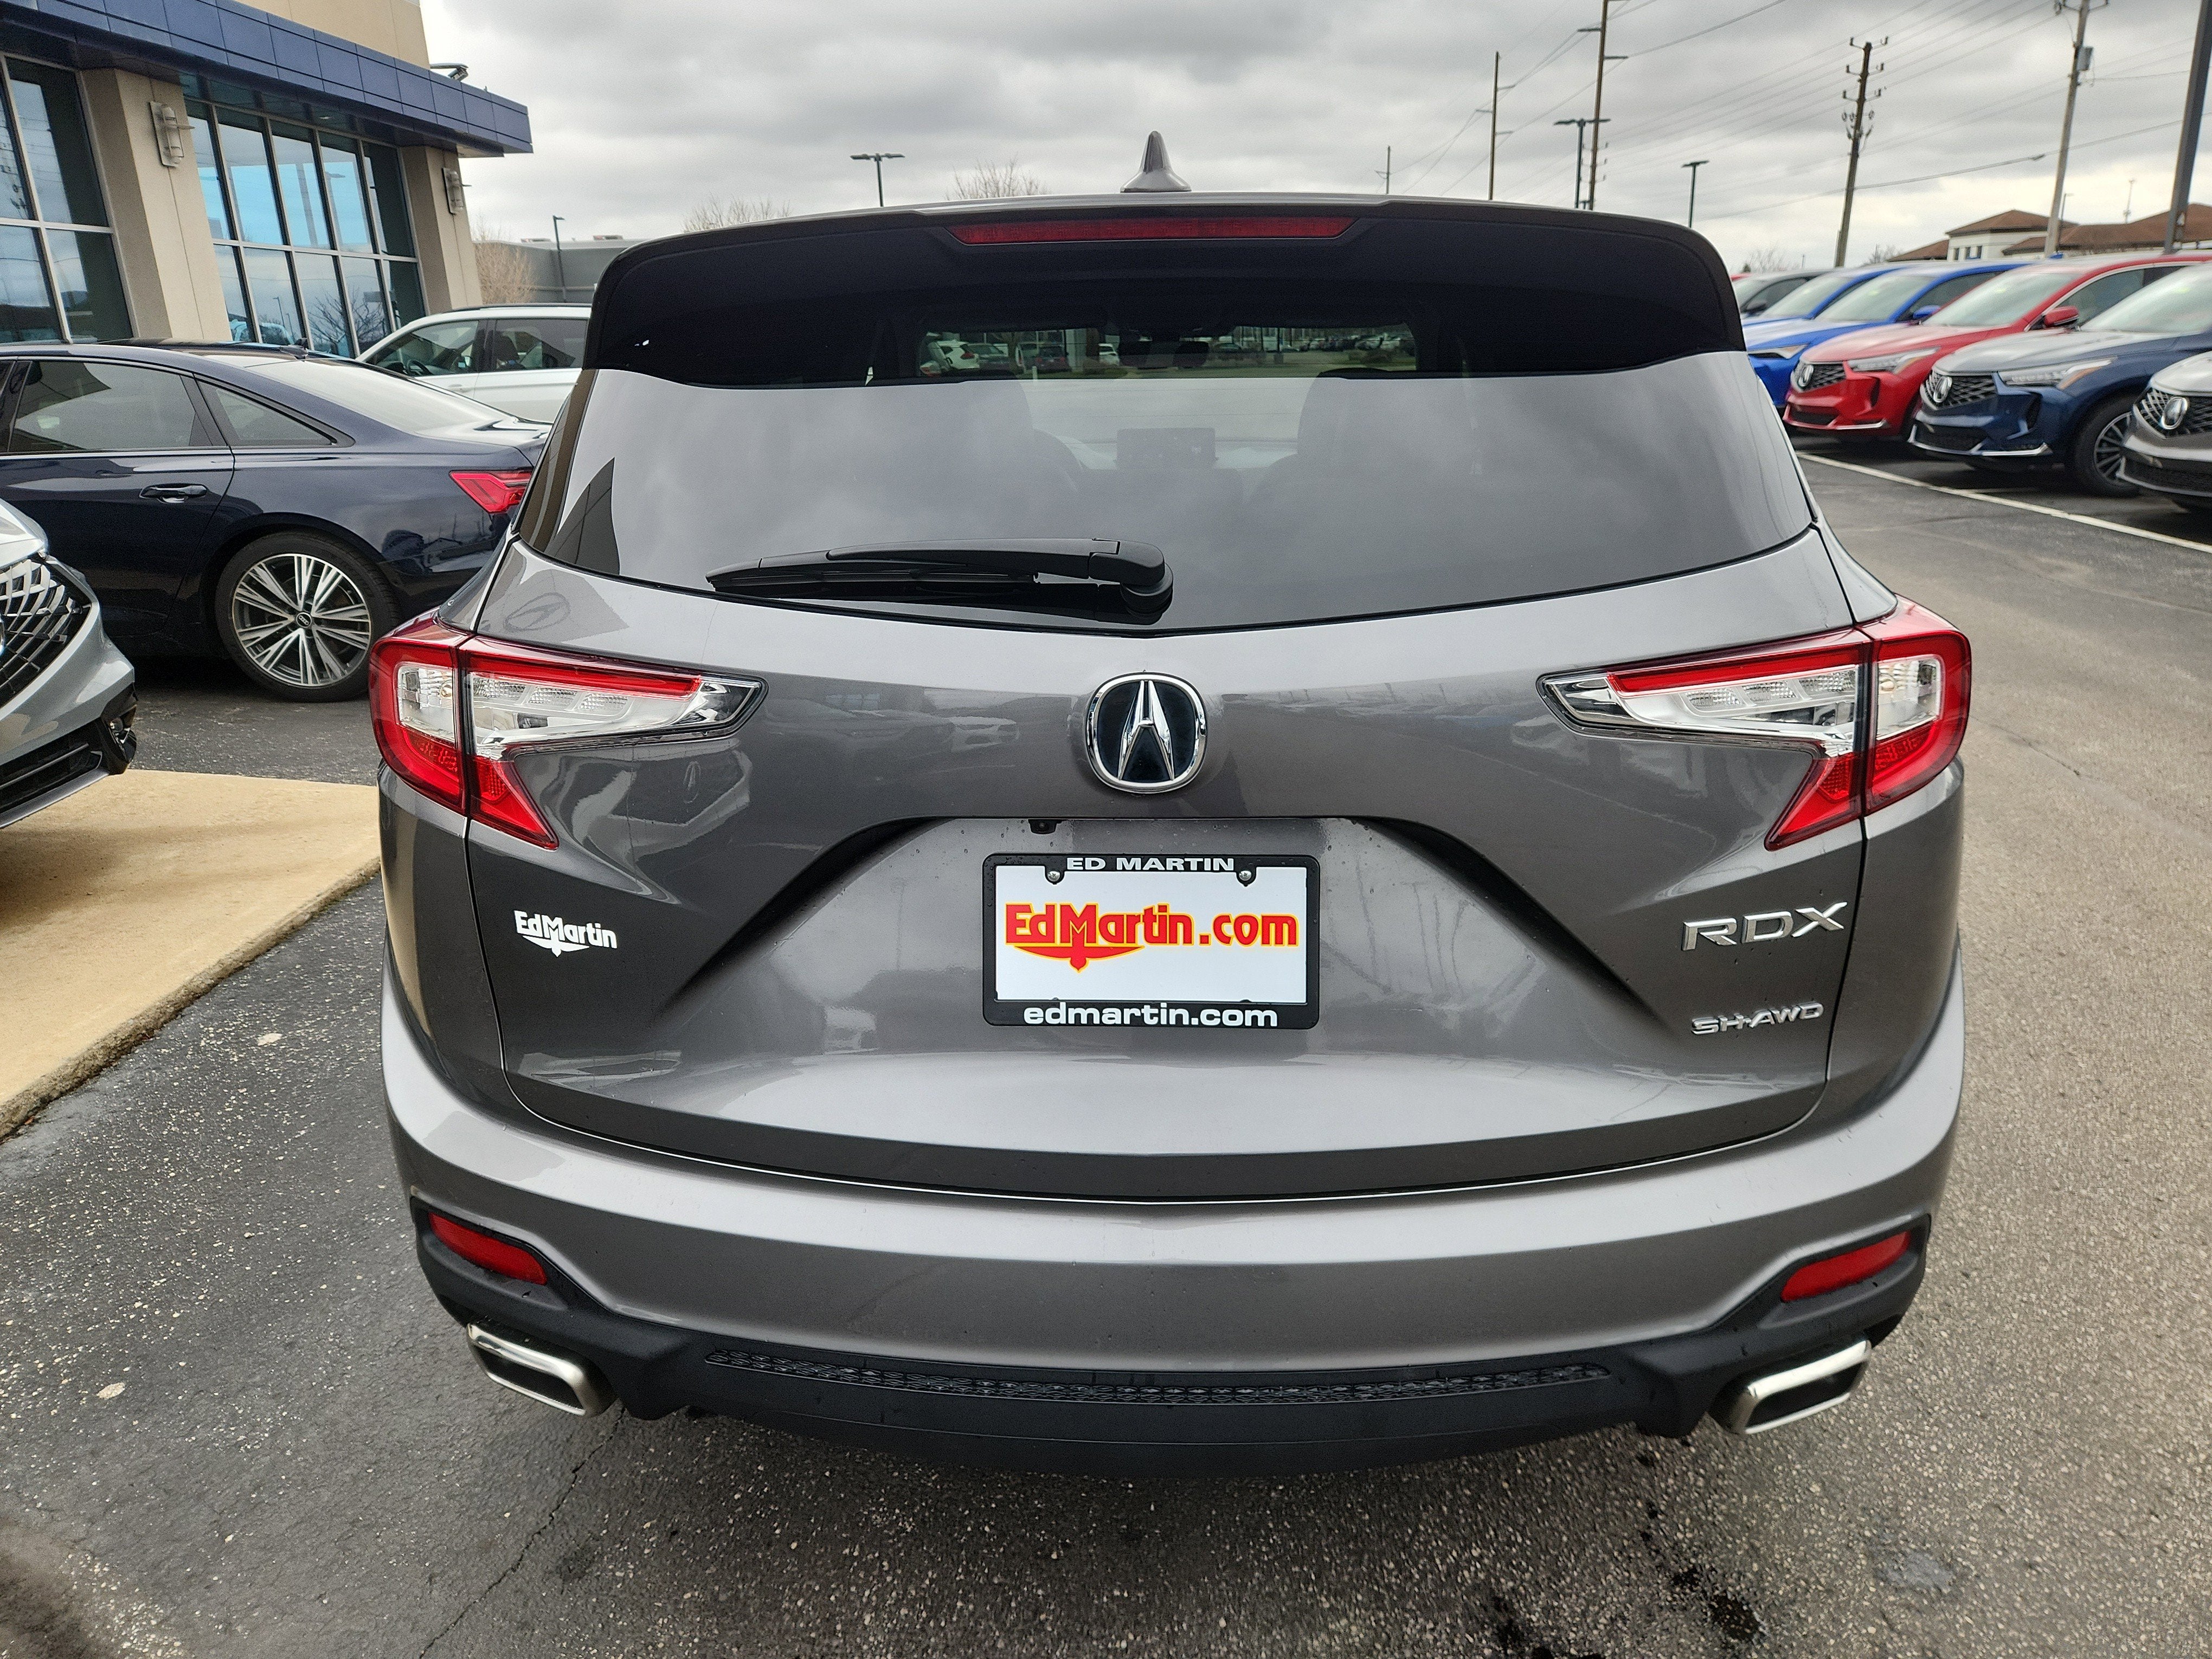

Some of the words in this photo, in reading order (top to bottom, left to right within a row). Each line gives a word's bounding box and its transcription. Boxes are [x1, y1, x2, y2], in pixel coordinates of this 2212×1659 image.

[1066, 857, 1106, 871] ED
[1116, 857, 1234, 871] MARTIN
[514, 910, 618, 949] EdMartin
[1005, 902, 1299, 948] EdMartin.com
[1681, 902, 1848, 951] RDX
[1023, 1002, 1278, 1027] edmartin.com
[1691, 1002, 1824, 1035] SH-AWD
